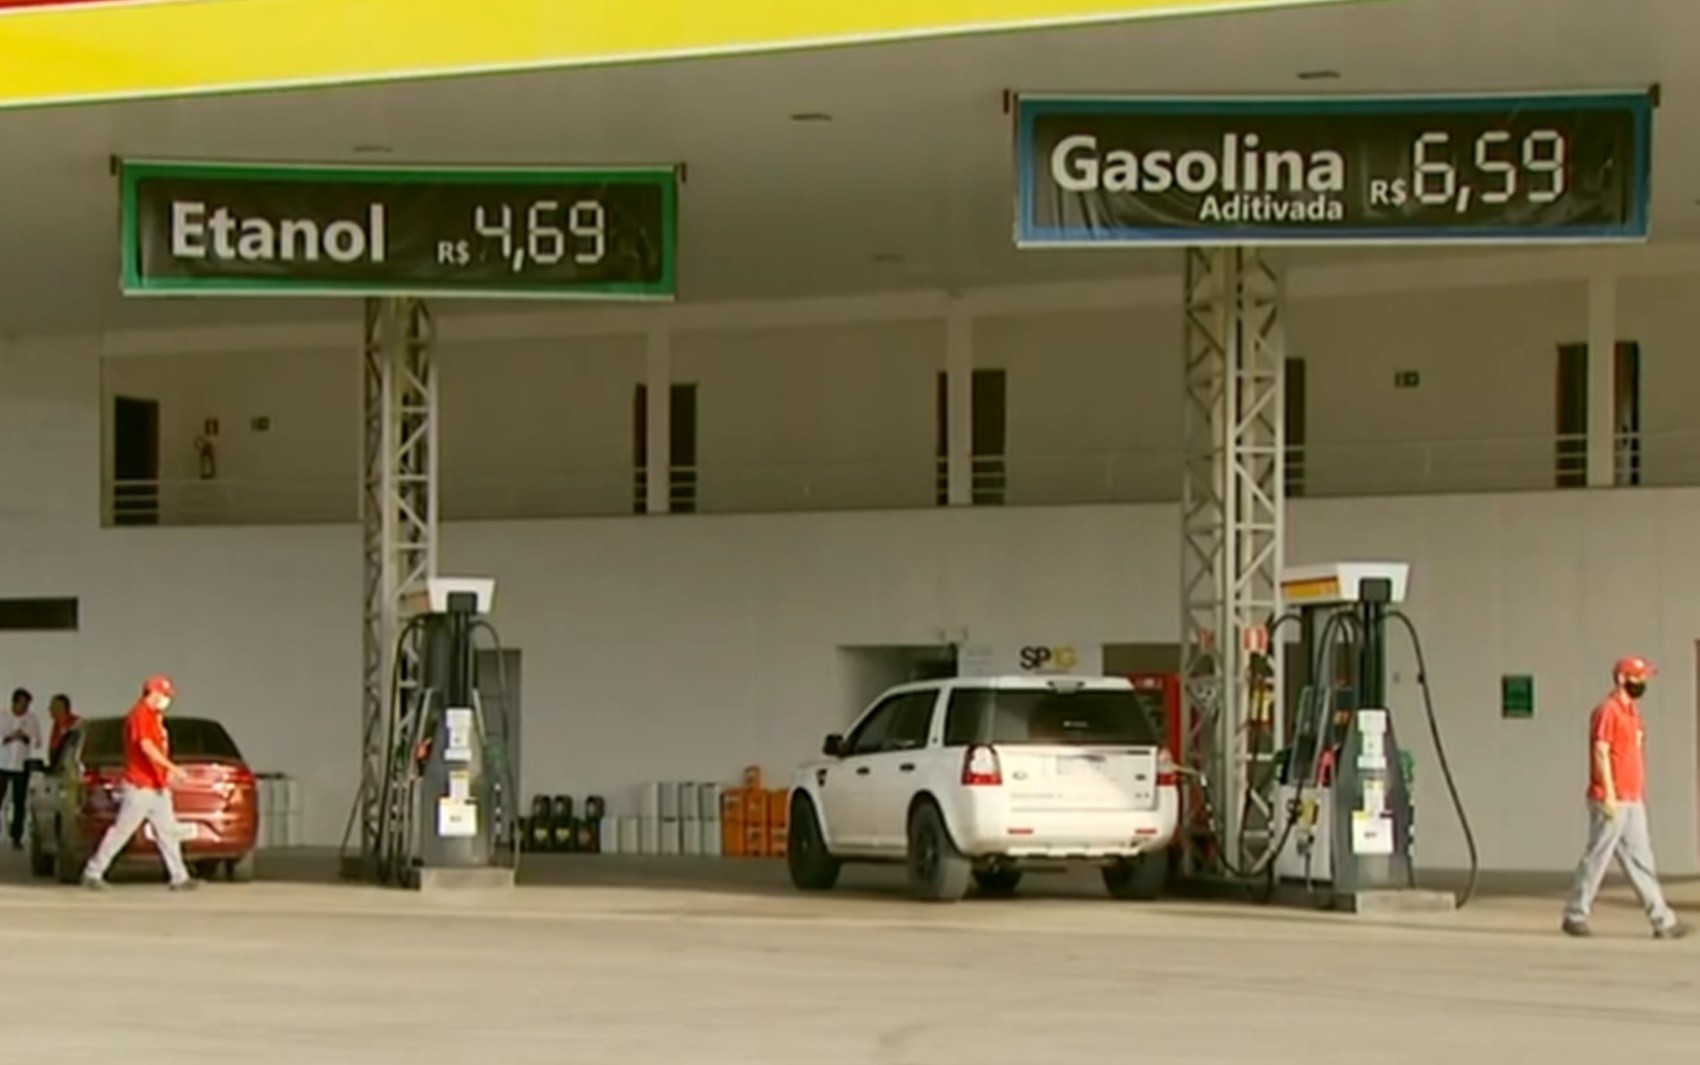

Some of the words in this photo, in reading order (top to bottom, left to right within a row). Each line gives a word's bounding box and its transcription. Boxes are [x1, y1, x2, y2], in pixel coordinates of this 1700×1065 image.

[1051, 133, 1345, 193] Gasolina
[1370, 178, 1407, 207] R$
[1414, 130, 1565, 213] 6,59
[172, 201, 384, 262] Etanol
[437, 239, 471, 266] R$
[475, 200, 604, 272] 4,69
[1199, 195, 1344, 221] Aditivada
